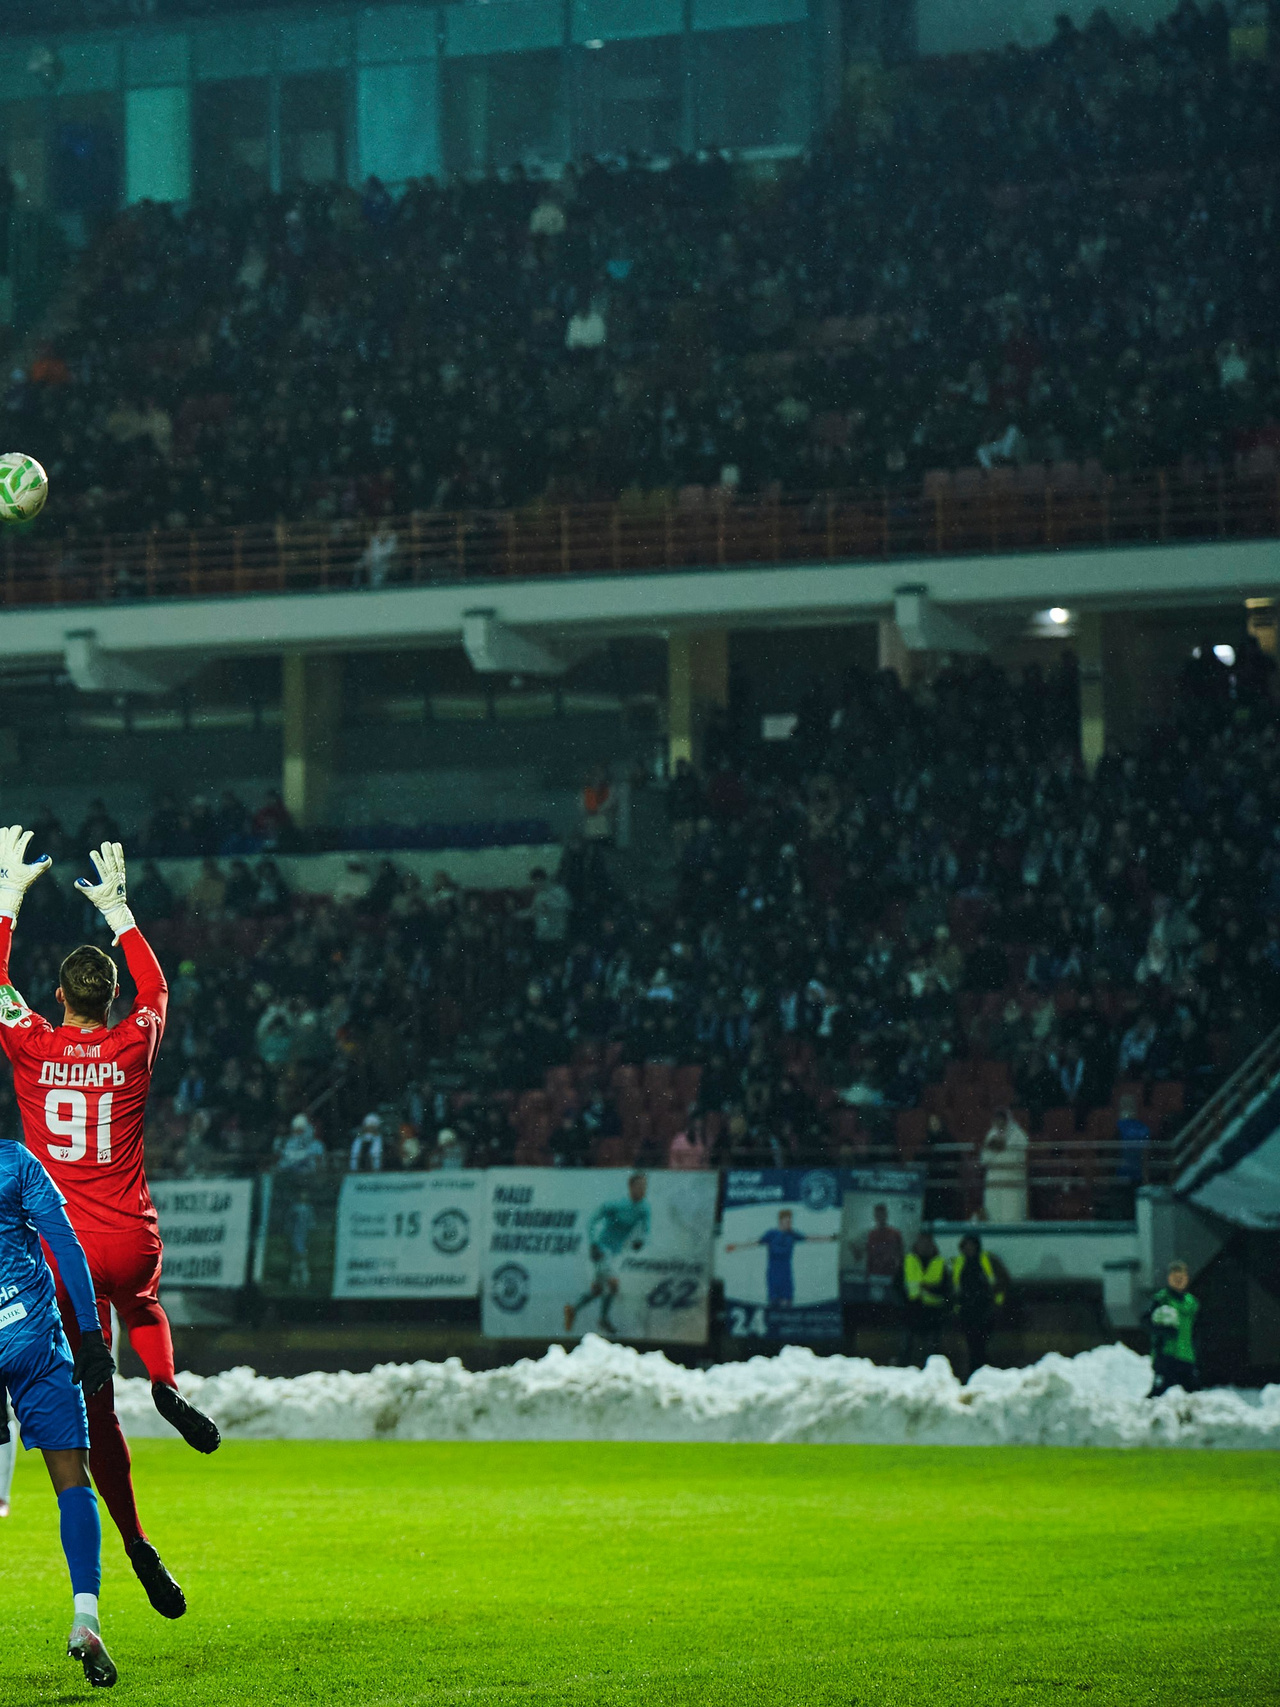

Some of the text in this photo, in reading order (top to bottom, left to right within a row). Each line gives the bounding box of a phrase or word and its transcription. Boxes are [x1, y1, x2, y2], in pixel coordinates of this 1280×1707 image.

[38, 1061, 125, 1087] ДУДАРЬ
[44, 1088, 114, 1164] 91
[395, 1212, 420, 1238] 15
[646, 1279, 700, 1311] 62
[730, 1308, 768, 1337] 24
